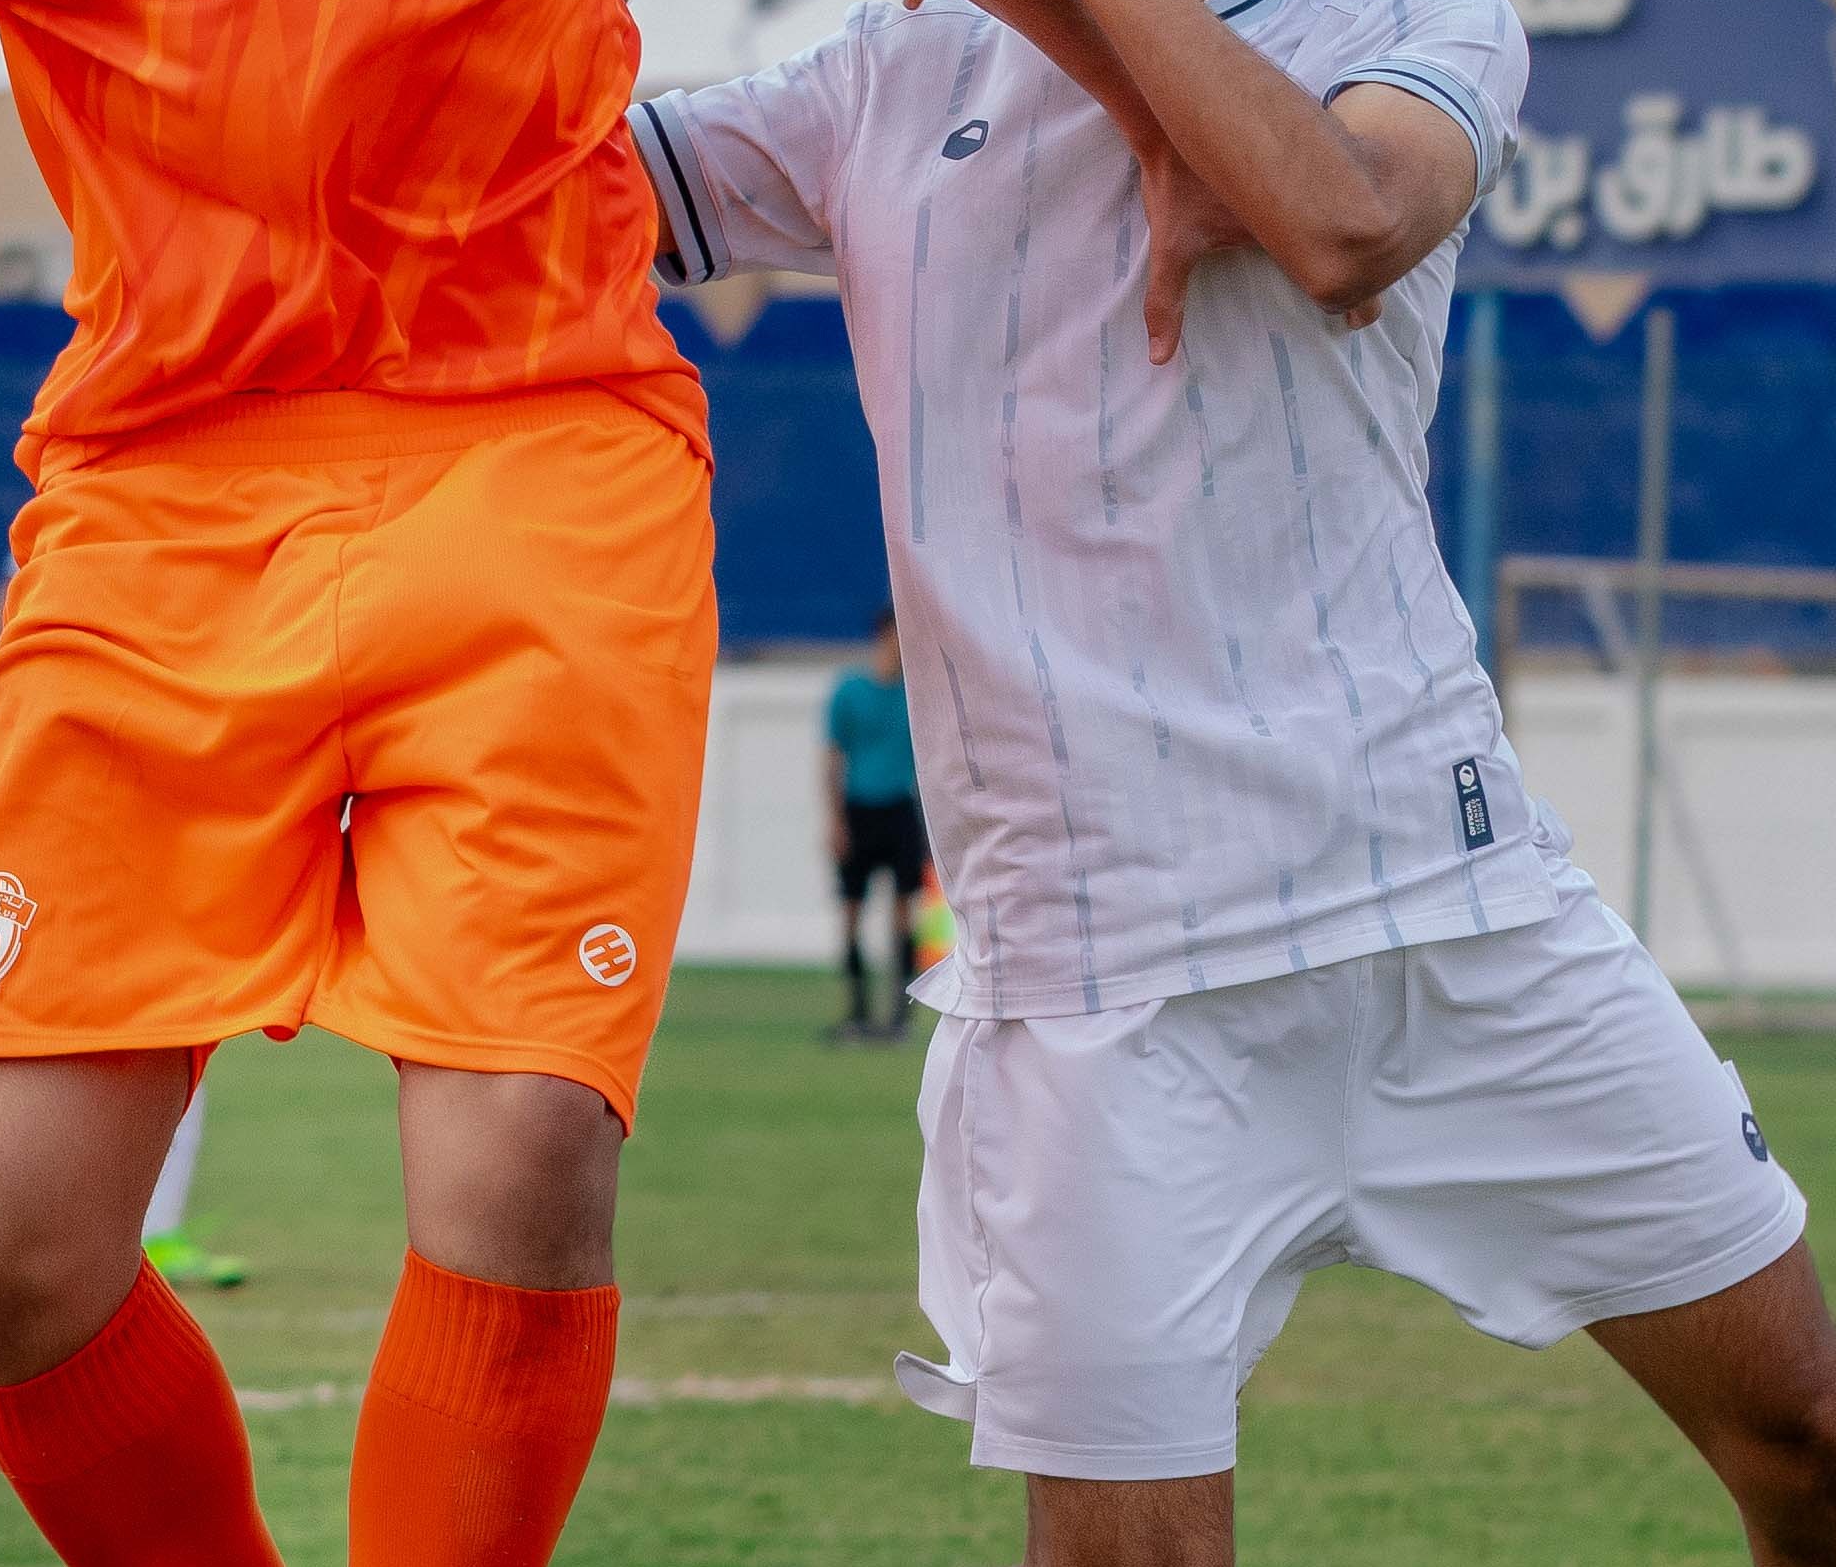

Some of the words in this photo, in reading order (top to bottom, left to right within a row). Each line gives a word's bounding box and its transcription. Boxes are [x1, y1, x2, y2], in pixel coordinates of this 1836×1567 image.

[1592, 91, 1822, 242] طارق
[1465, 799, 1477, 836] OFFICIAL
[1476, 798, 1487, 833] PRODUCT
